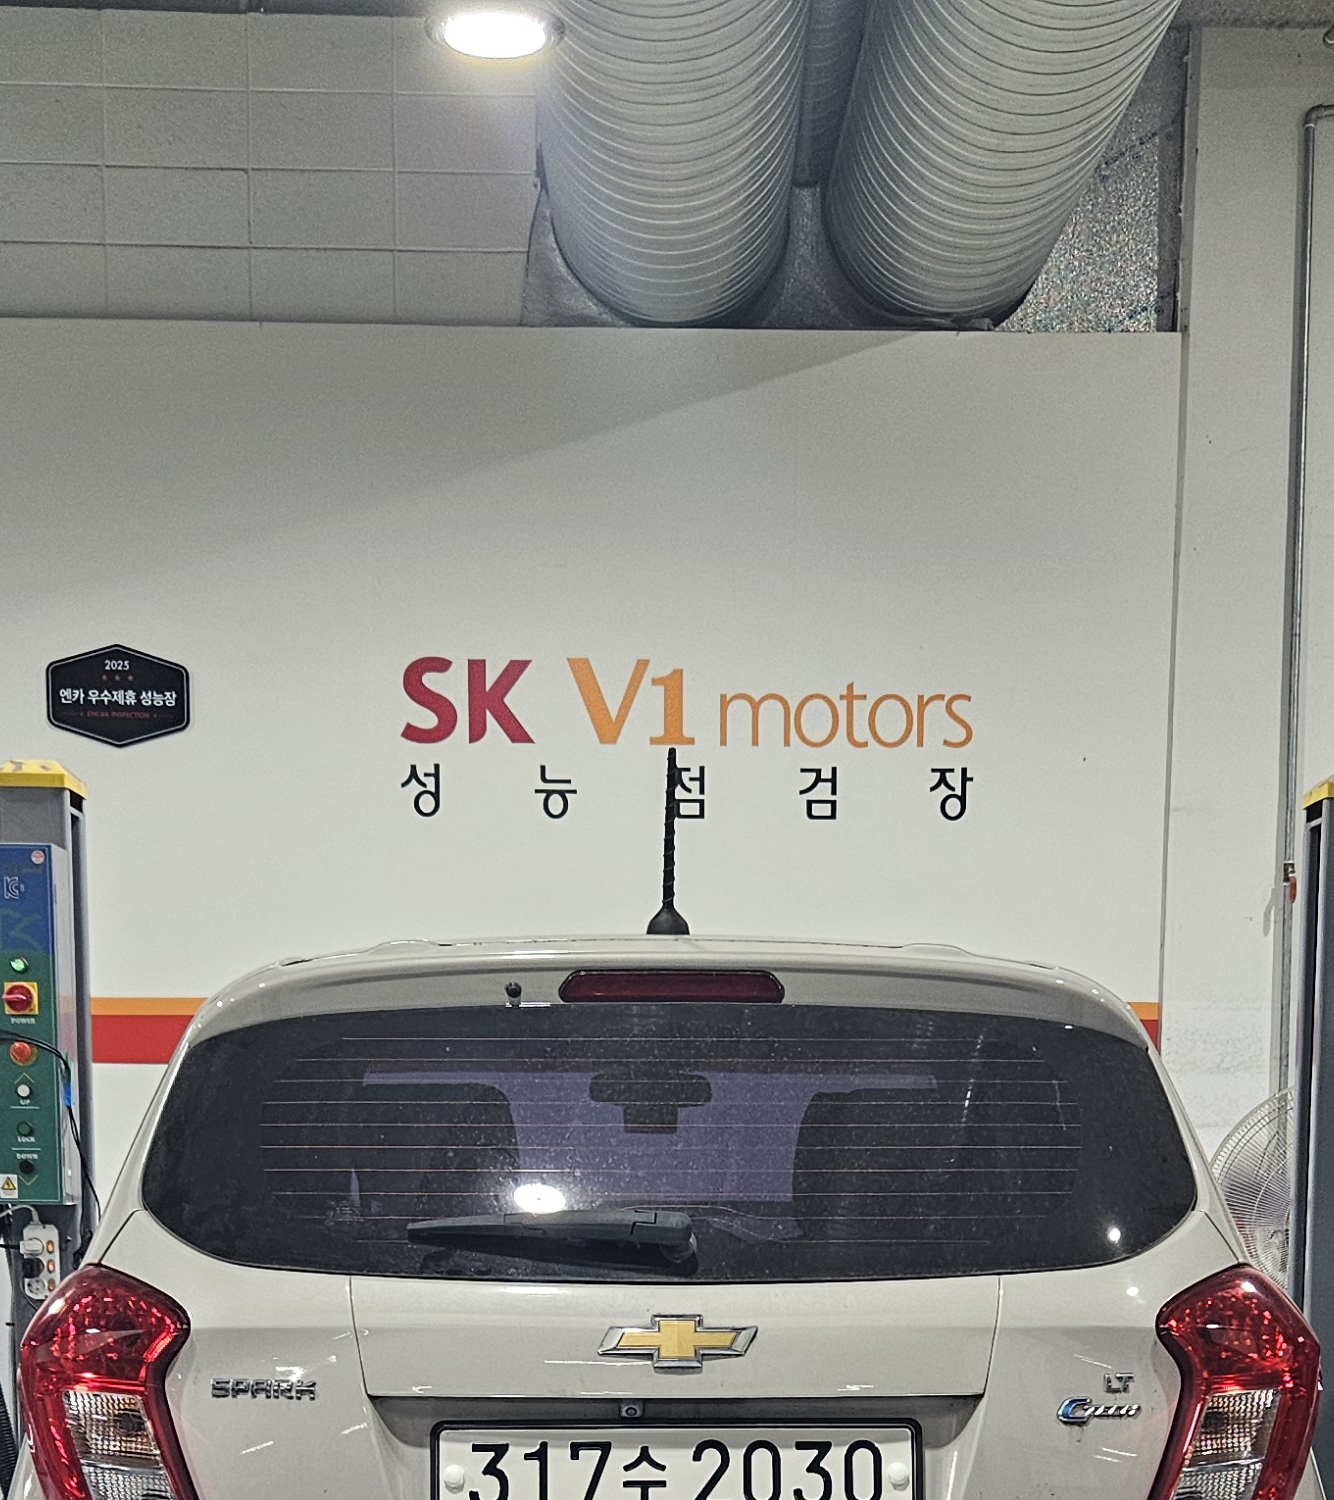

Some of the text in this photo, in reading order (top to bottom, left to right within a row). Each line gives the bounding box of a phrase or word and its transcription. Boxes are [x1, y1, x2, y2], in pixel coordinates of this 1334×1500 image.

[104, 660, 130, 670] 2025
[59, 687, 177, 707] 엔카 우수제휴 성능장
[400, 656, 973, 749] SK V1 motors
[10, 1017, 36, 1025] POWER
[210, 1379, 317, 1401] SPARK
[1103, 1372, 1135, 1394] LT
